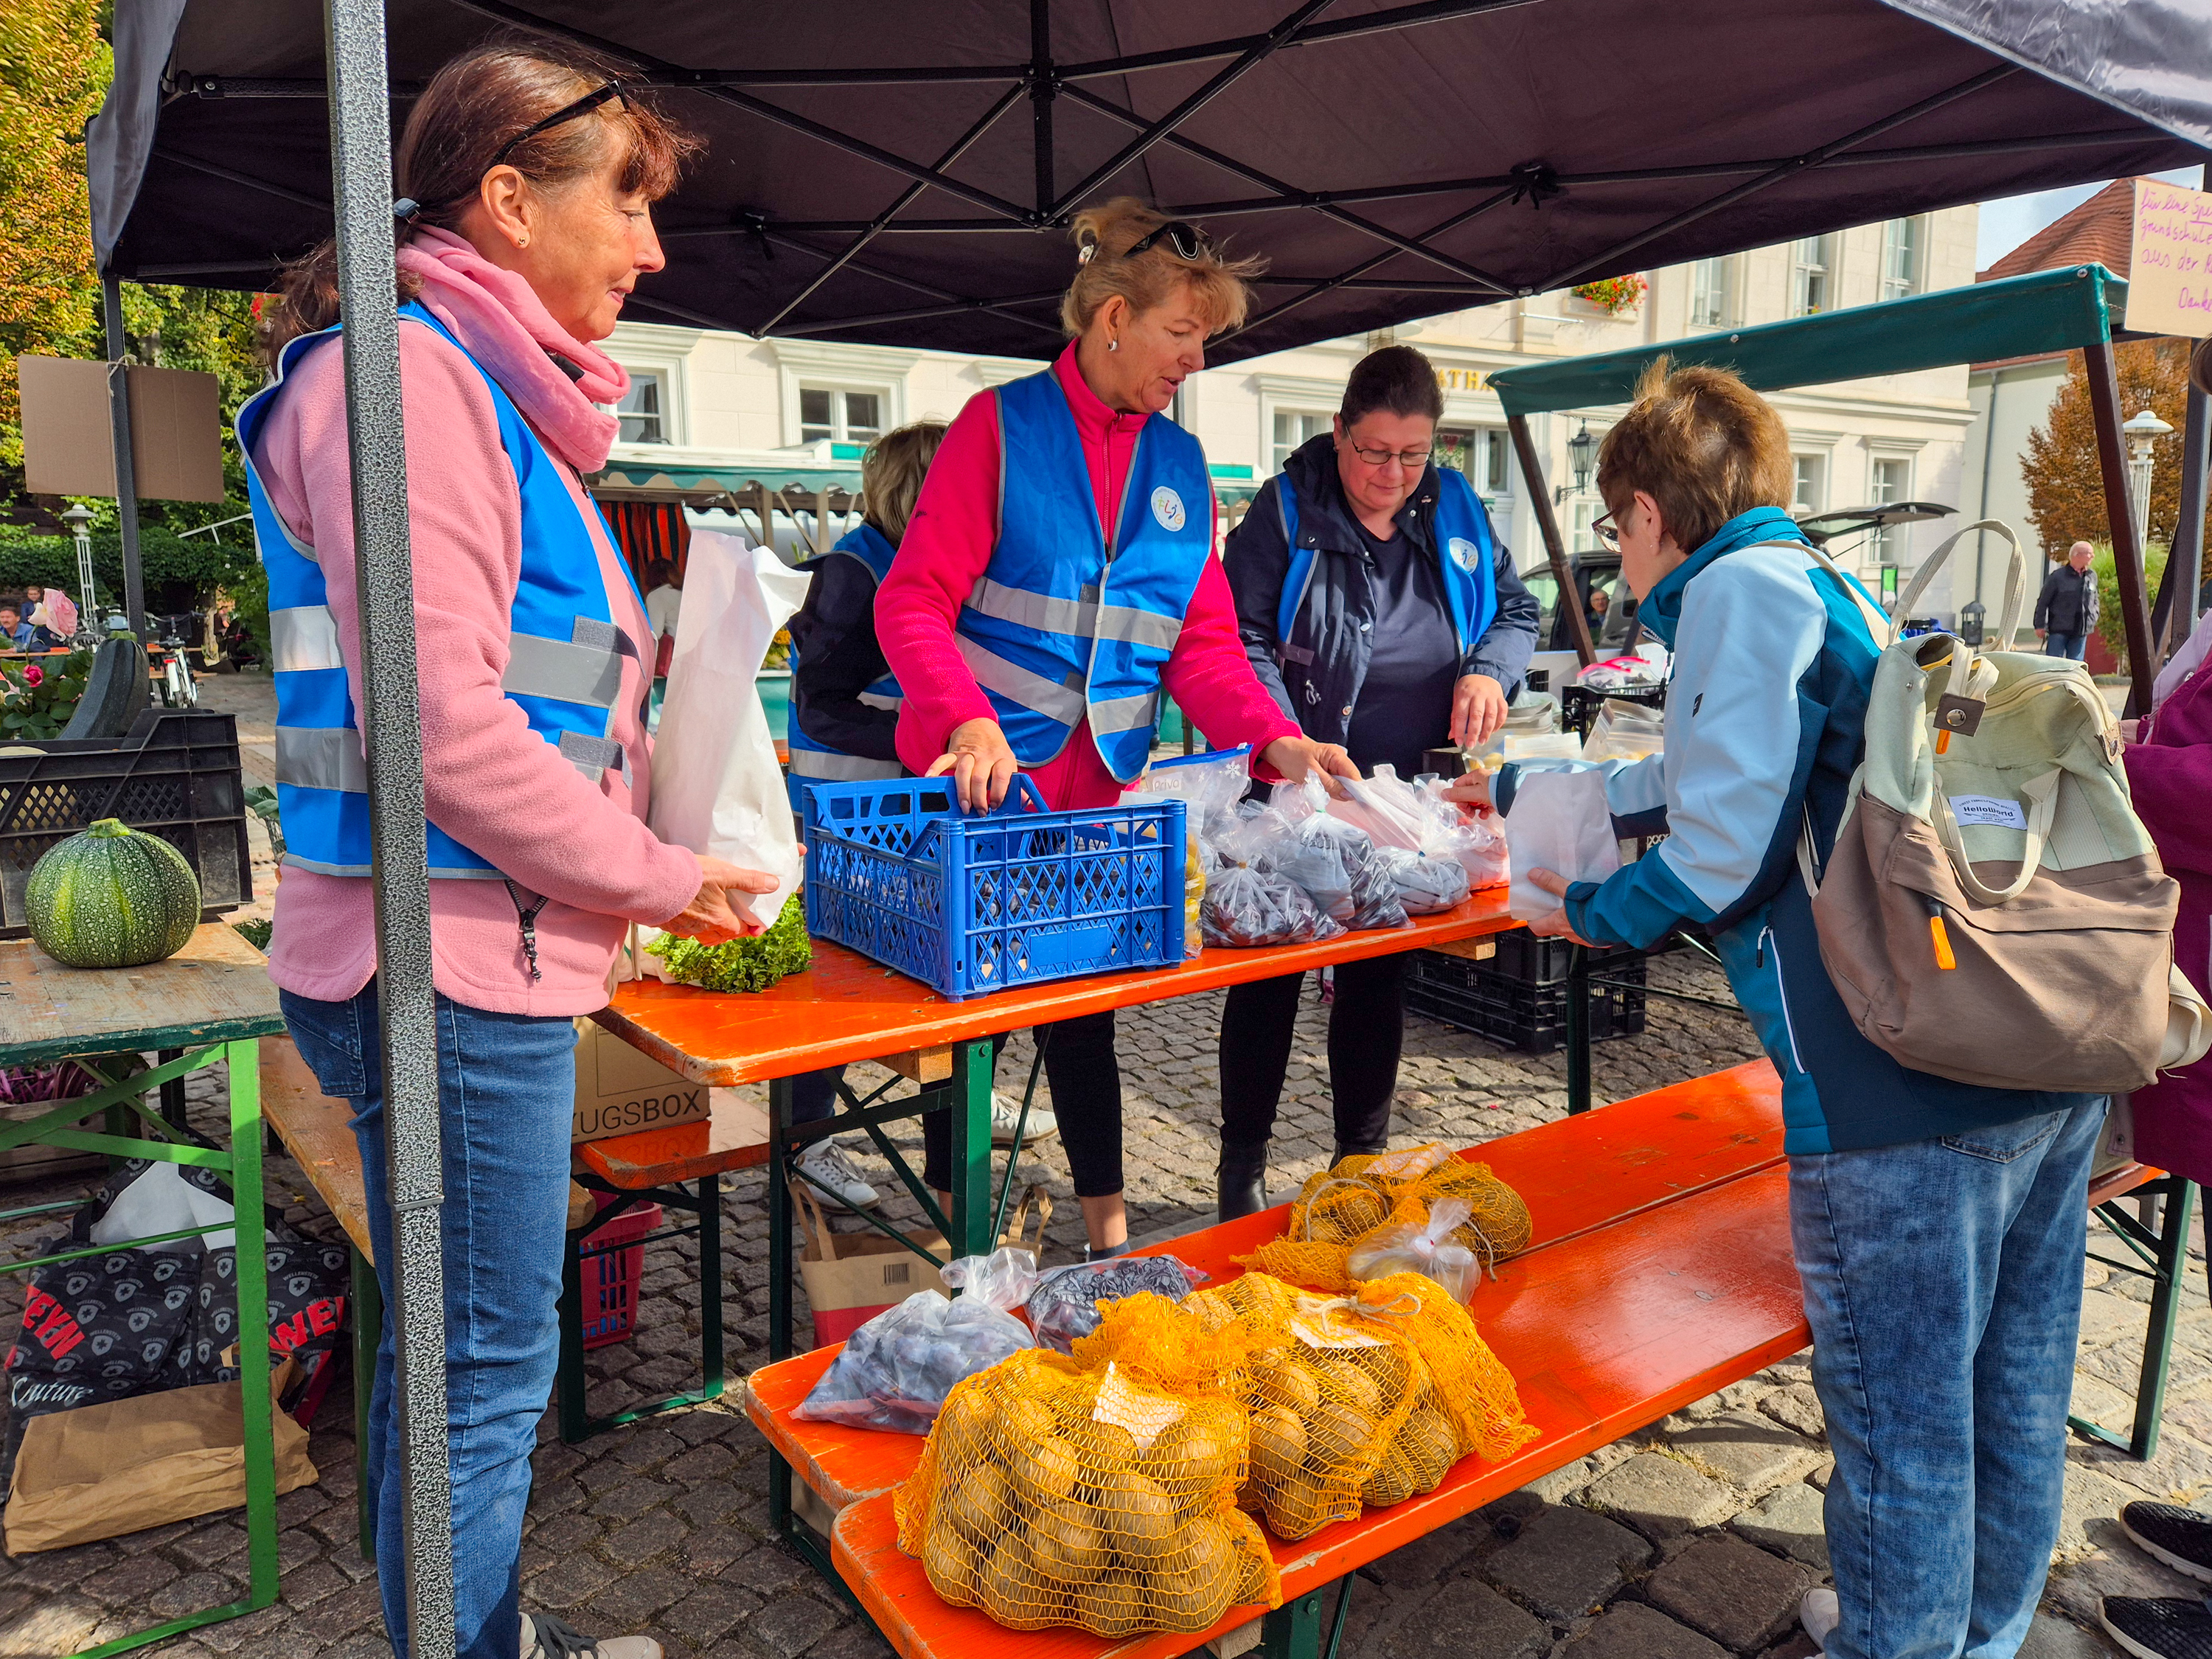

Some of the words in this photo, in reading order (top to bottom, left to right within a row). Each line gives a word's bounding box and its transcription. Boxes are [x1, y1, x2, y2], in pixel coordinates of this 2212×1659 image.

[2140, 187, 2162, 215] für
[2162, 194, 2189, 214] eine
[2141, 248, 2170, 268] aus
[2177, 247, 2199, 271] der
[1964, 806, 2014, 817] HelloWorld
